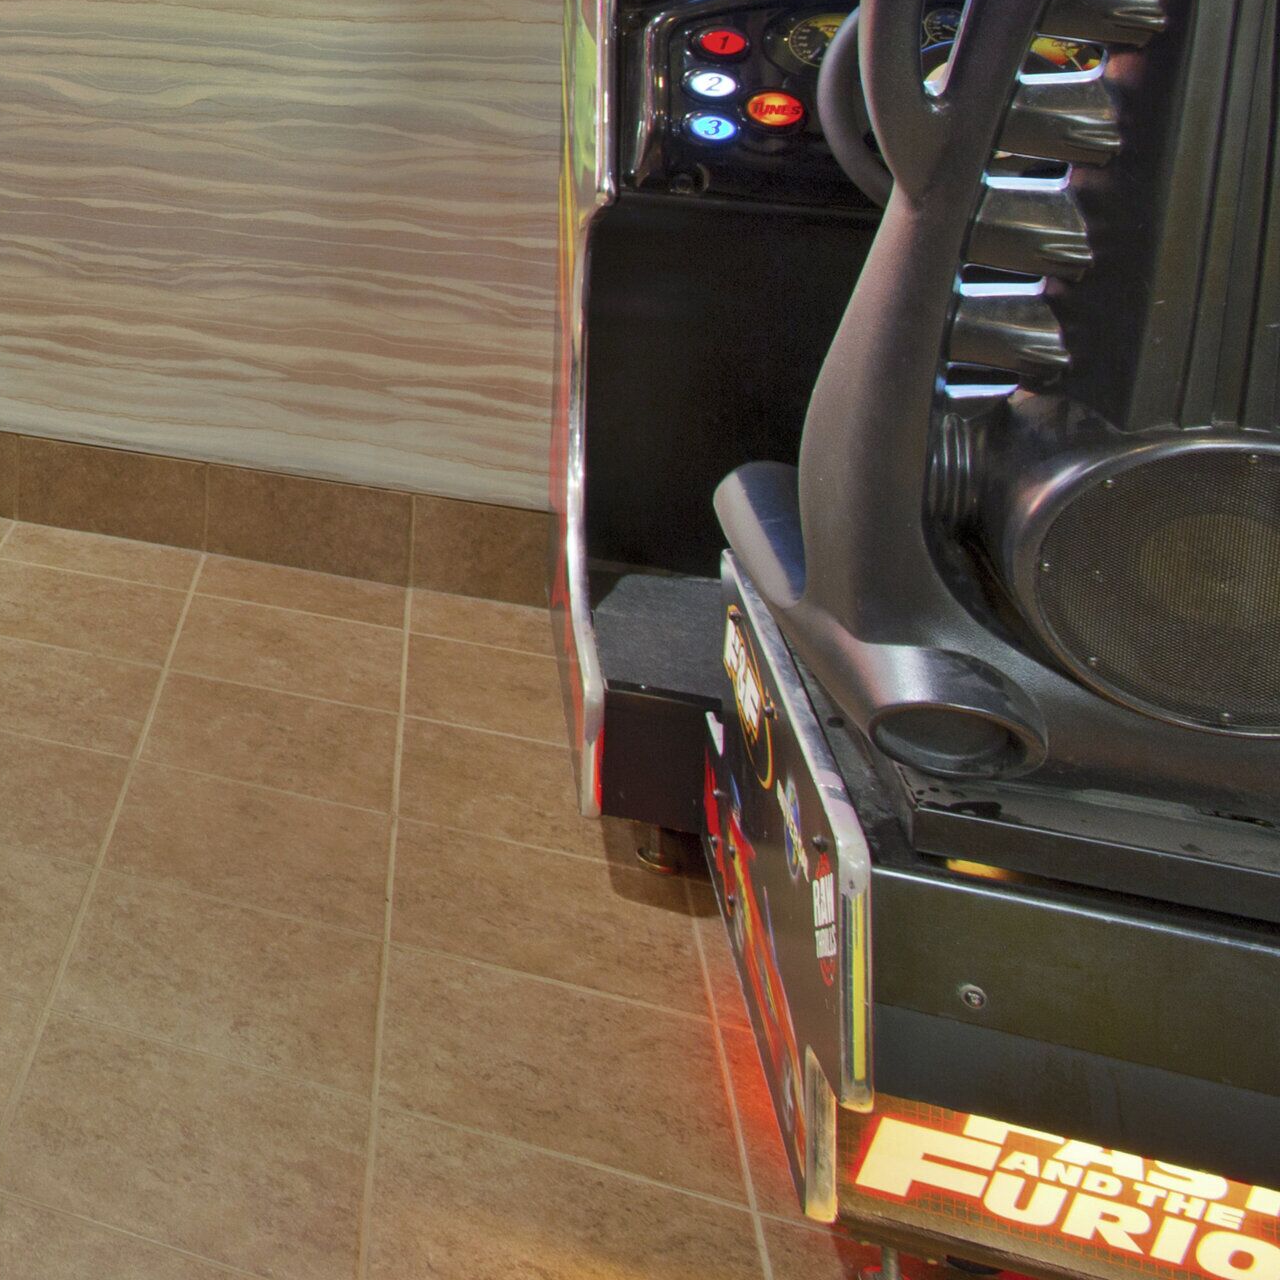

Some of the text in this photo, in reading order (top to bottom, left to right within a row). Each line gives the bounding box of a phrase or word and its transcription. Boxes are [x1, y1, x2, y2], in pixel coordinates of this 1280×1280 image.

[715, 35, 730, 50] 1
[705, 76, 723, 92] 2
[753, 101, 802, 116] TUNES
[704, 119, 723, 136] 3
[997, 1149, 1247, 1231] AND THE
